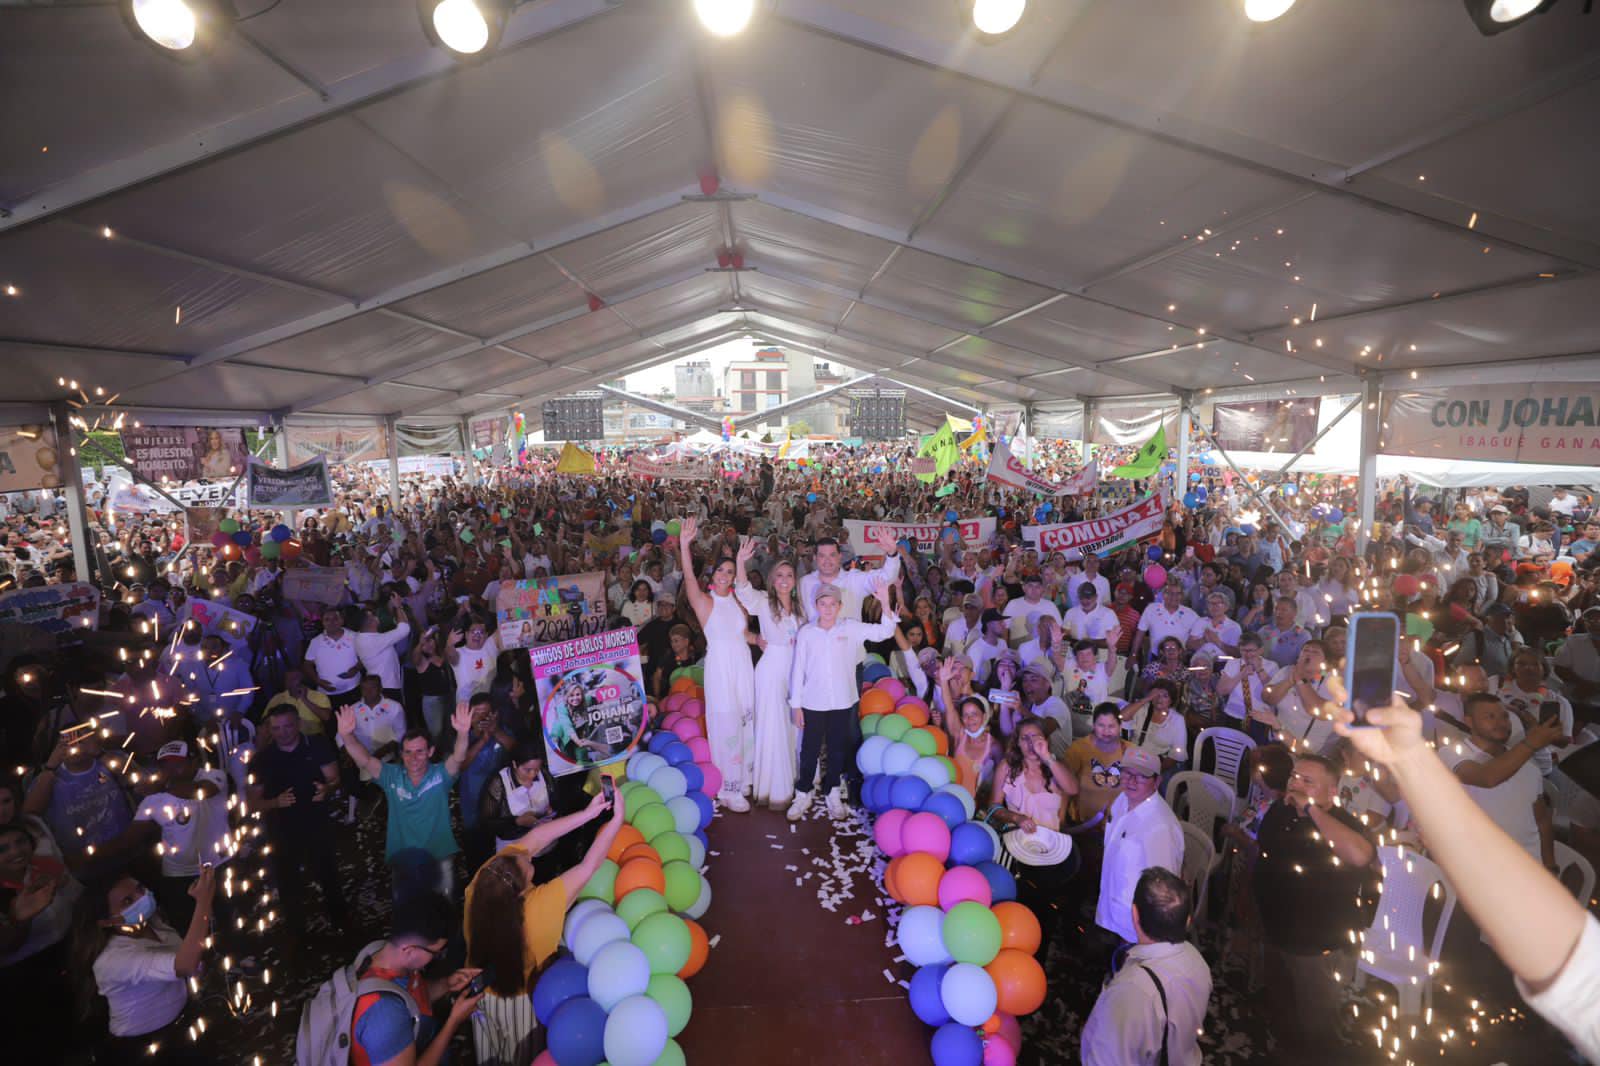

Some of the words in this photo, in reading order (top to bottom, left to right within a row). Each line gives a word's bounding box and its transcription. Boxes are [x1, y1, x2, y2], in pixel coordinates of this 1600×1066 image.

[1431, 399, 1490, 428] CON
[1498, 396, 1600, 432] JOHA
[136, 448, 149, 459] ES
[149, 447, 193, 459] NUESTRO
[1541, 437, 1600, 448] GANA
[867, 522, 940, 542] COMUN
[964, 524, 977, 539] 1
[1044, 506, 1142, 549] COMUNA
[1147, 499, 1160, 515] 1
[534, 646, 563, 667] AMIGOS
[564, 643, 575, 659] DE
[575, 636, 604, 656] CARLOS
[605, 629, 635, 650] MORENO
[544, 665, 562, 675] con
[564, 656, 596, 670] Johana
[599, 647, 630, 661] Aranda
[599, 687, 617, 700] YO
[588, 703, 634, 725] JOHANA
